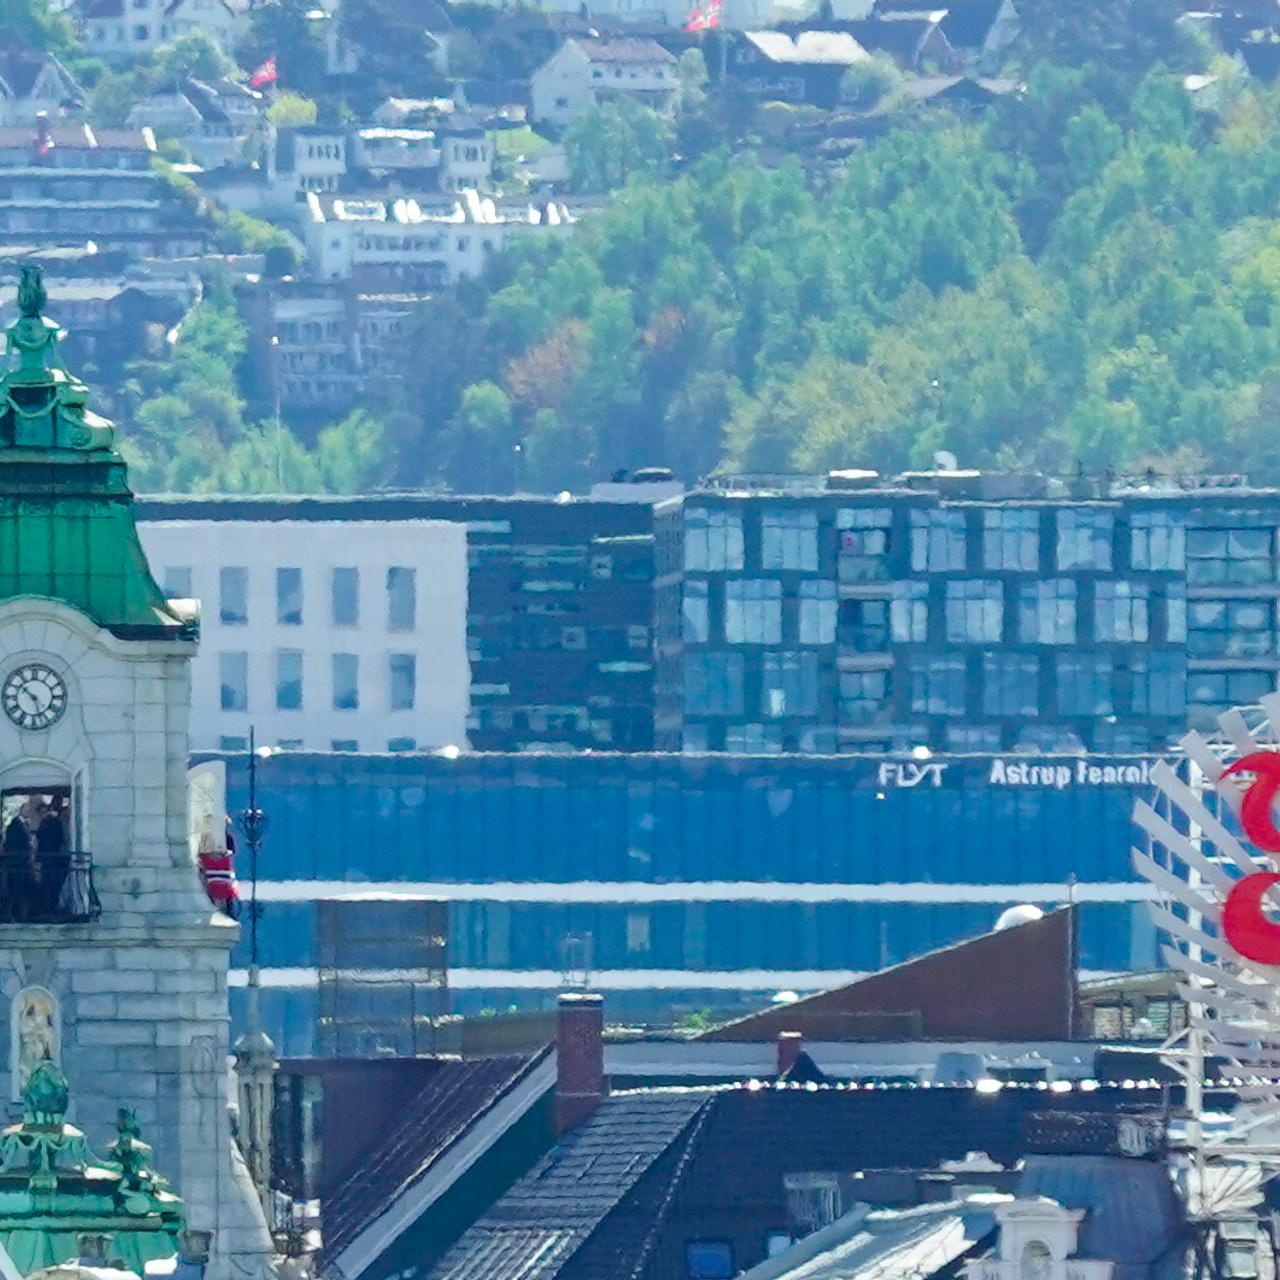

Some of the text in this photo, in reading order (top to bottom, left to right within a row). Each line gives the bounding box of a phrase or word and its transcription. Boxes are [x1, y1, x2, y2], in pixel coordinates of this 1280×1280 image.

[877, 762, 949, 787] FLYT
[989, 758, 1158, 790] Astrup Fearnl
